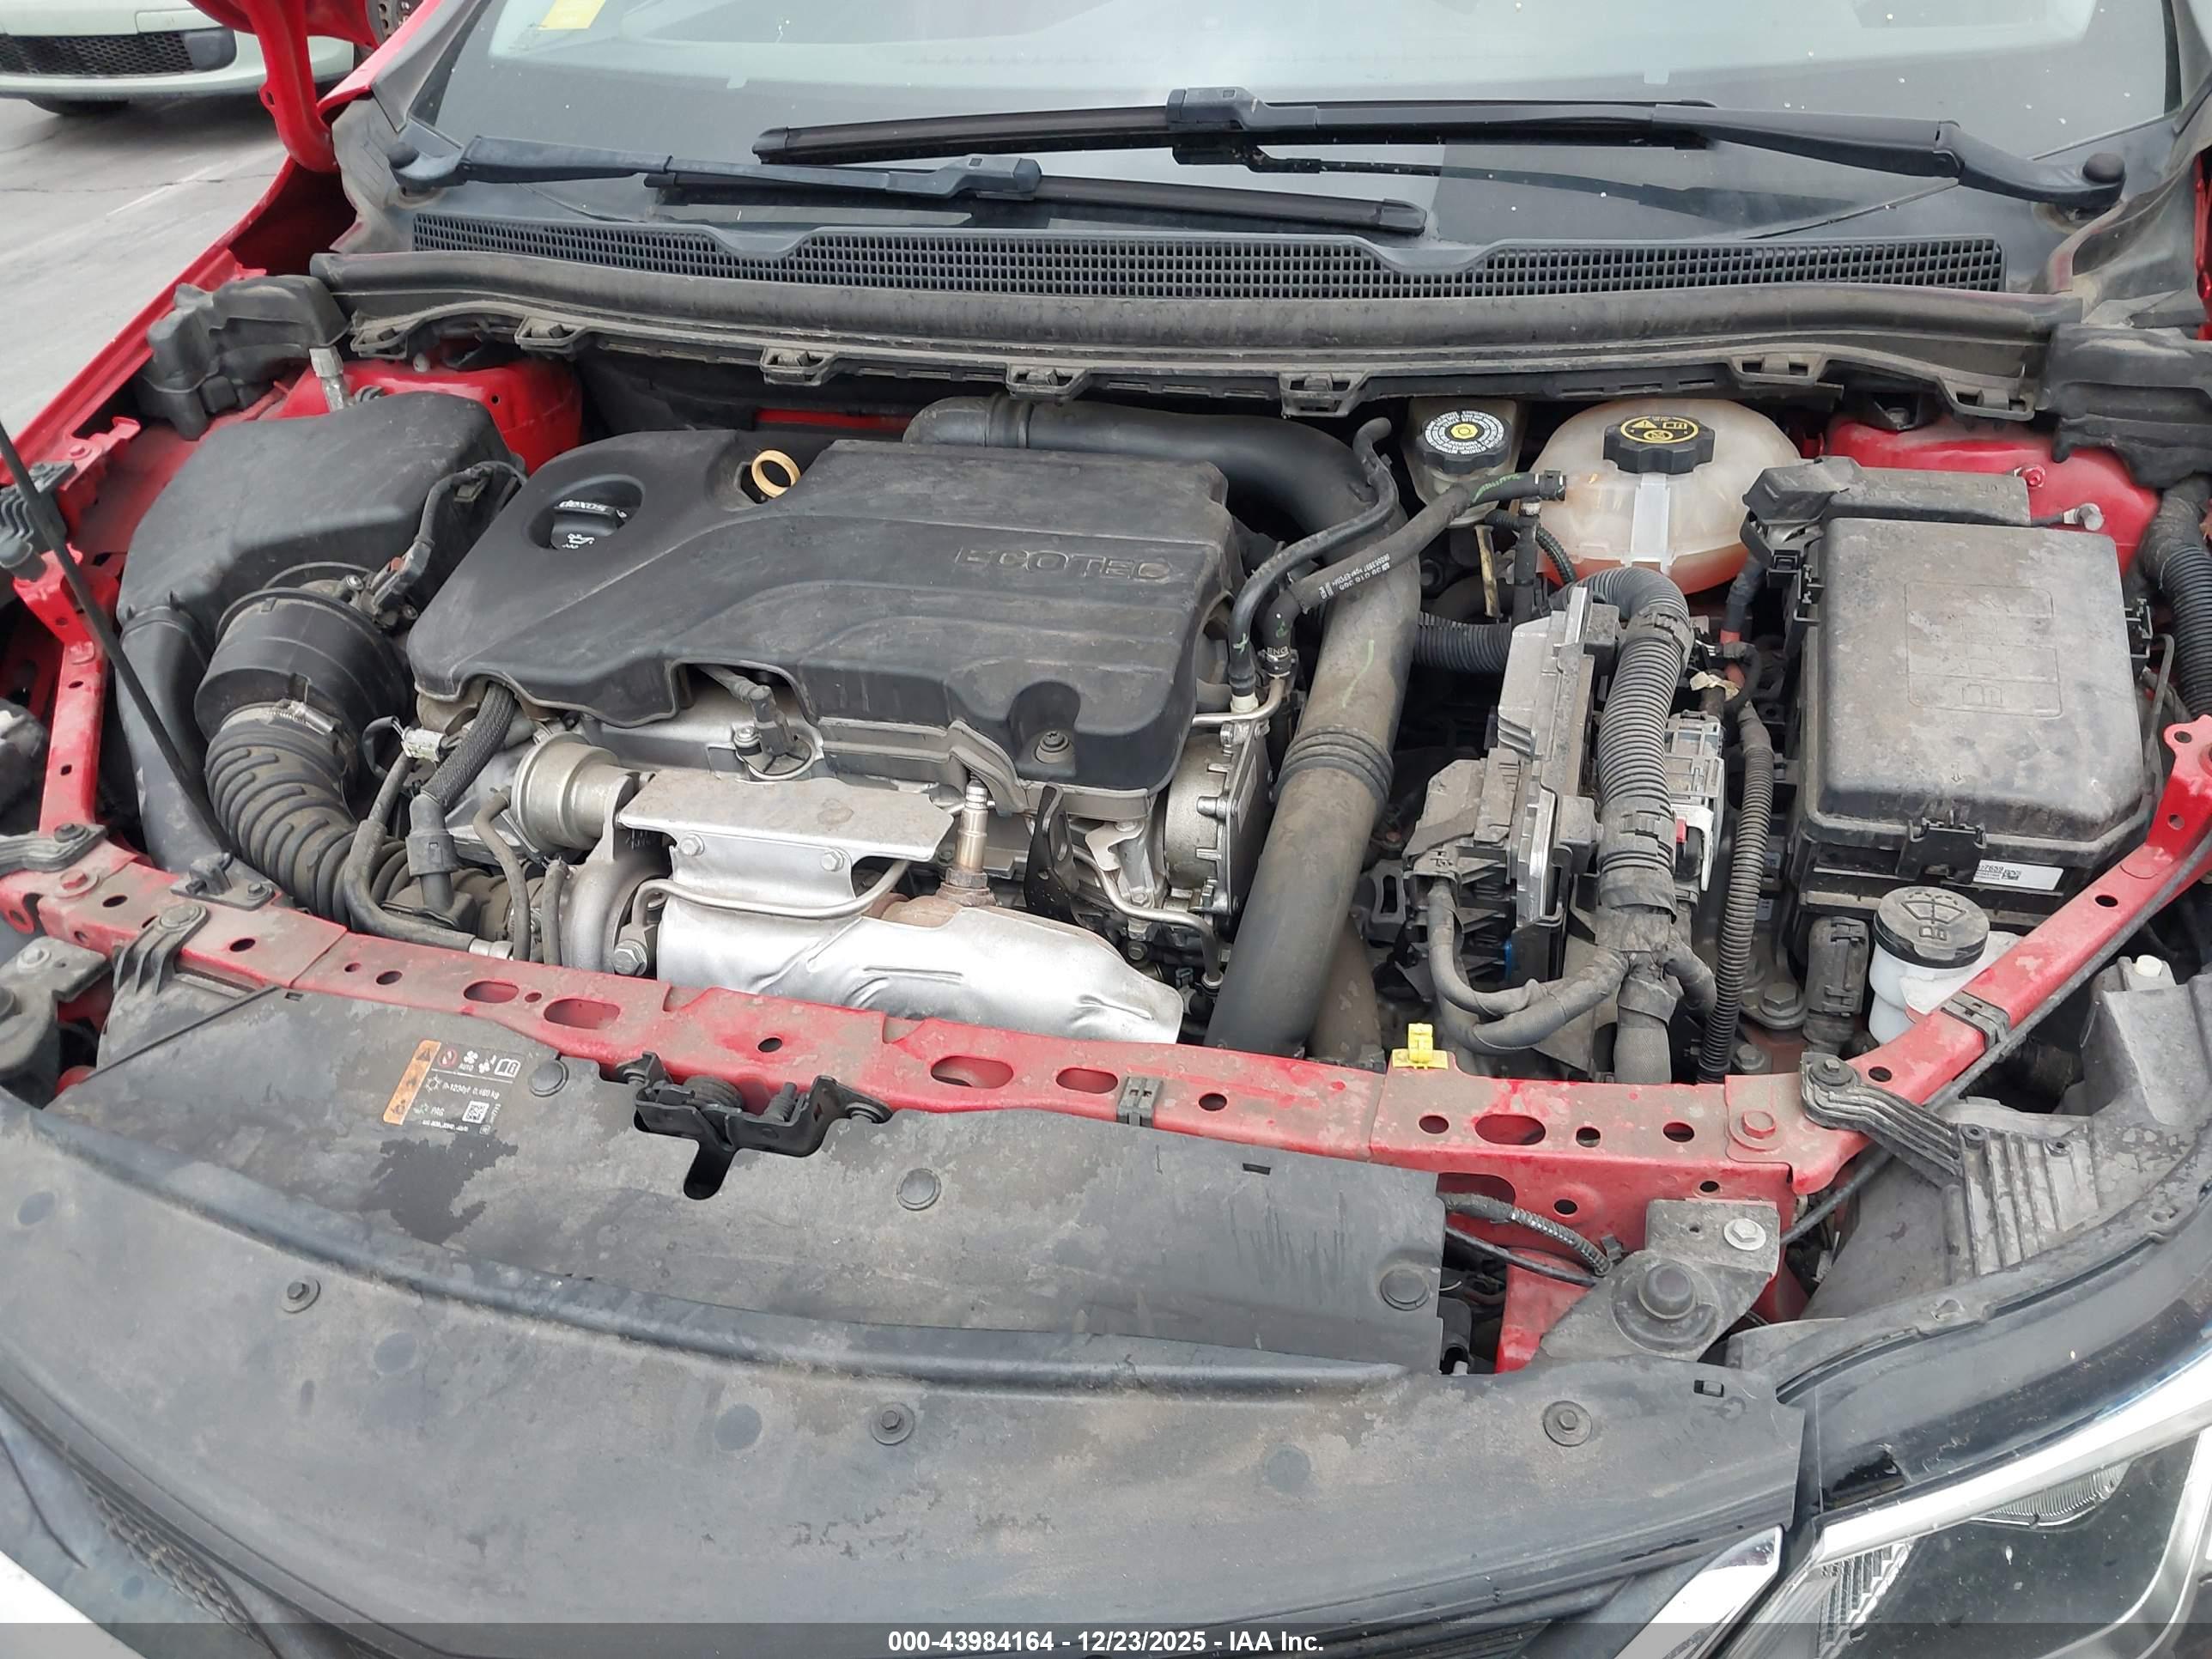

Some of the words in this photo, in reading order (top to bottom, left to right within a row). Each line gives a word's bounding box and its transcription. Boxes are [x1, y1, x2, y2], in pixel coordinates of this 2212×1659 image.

[955, 545, 1176, 583] ECOTEC
[458, 1063, 474, 1072] AUTO
[490, 1090, 500, 1100] kg
